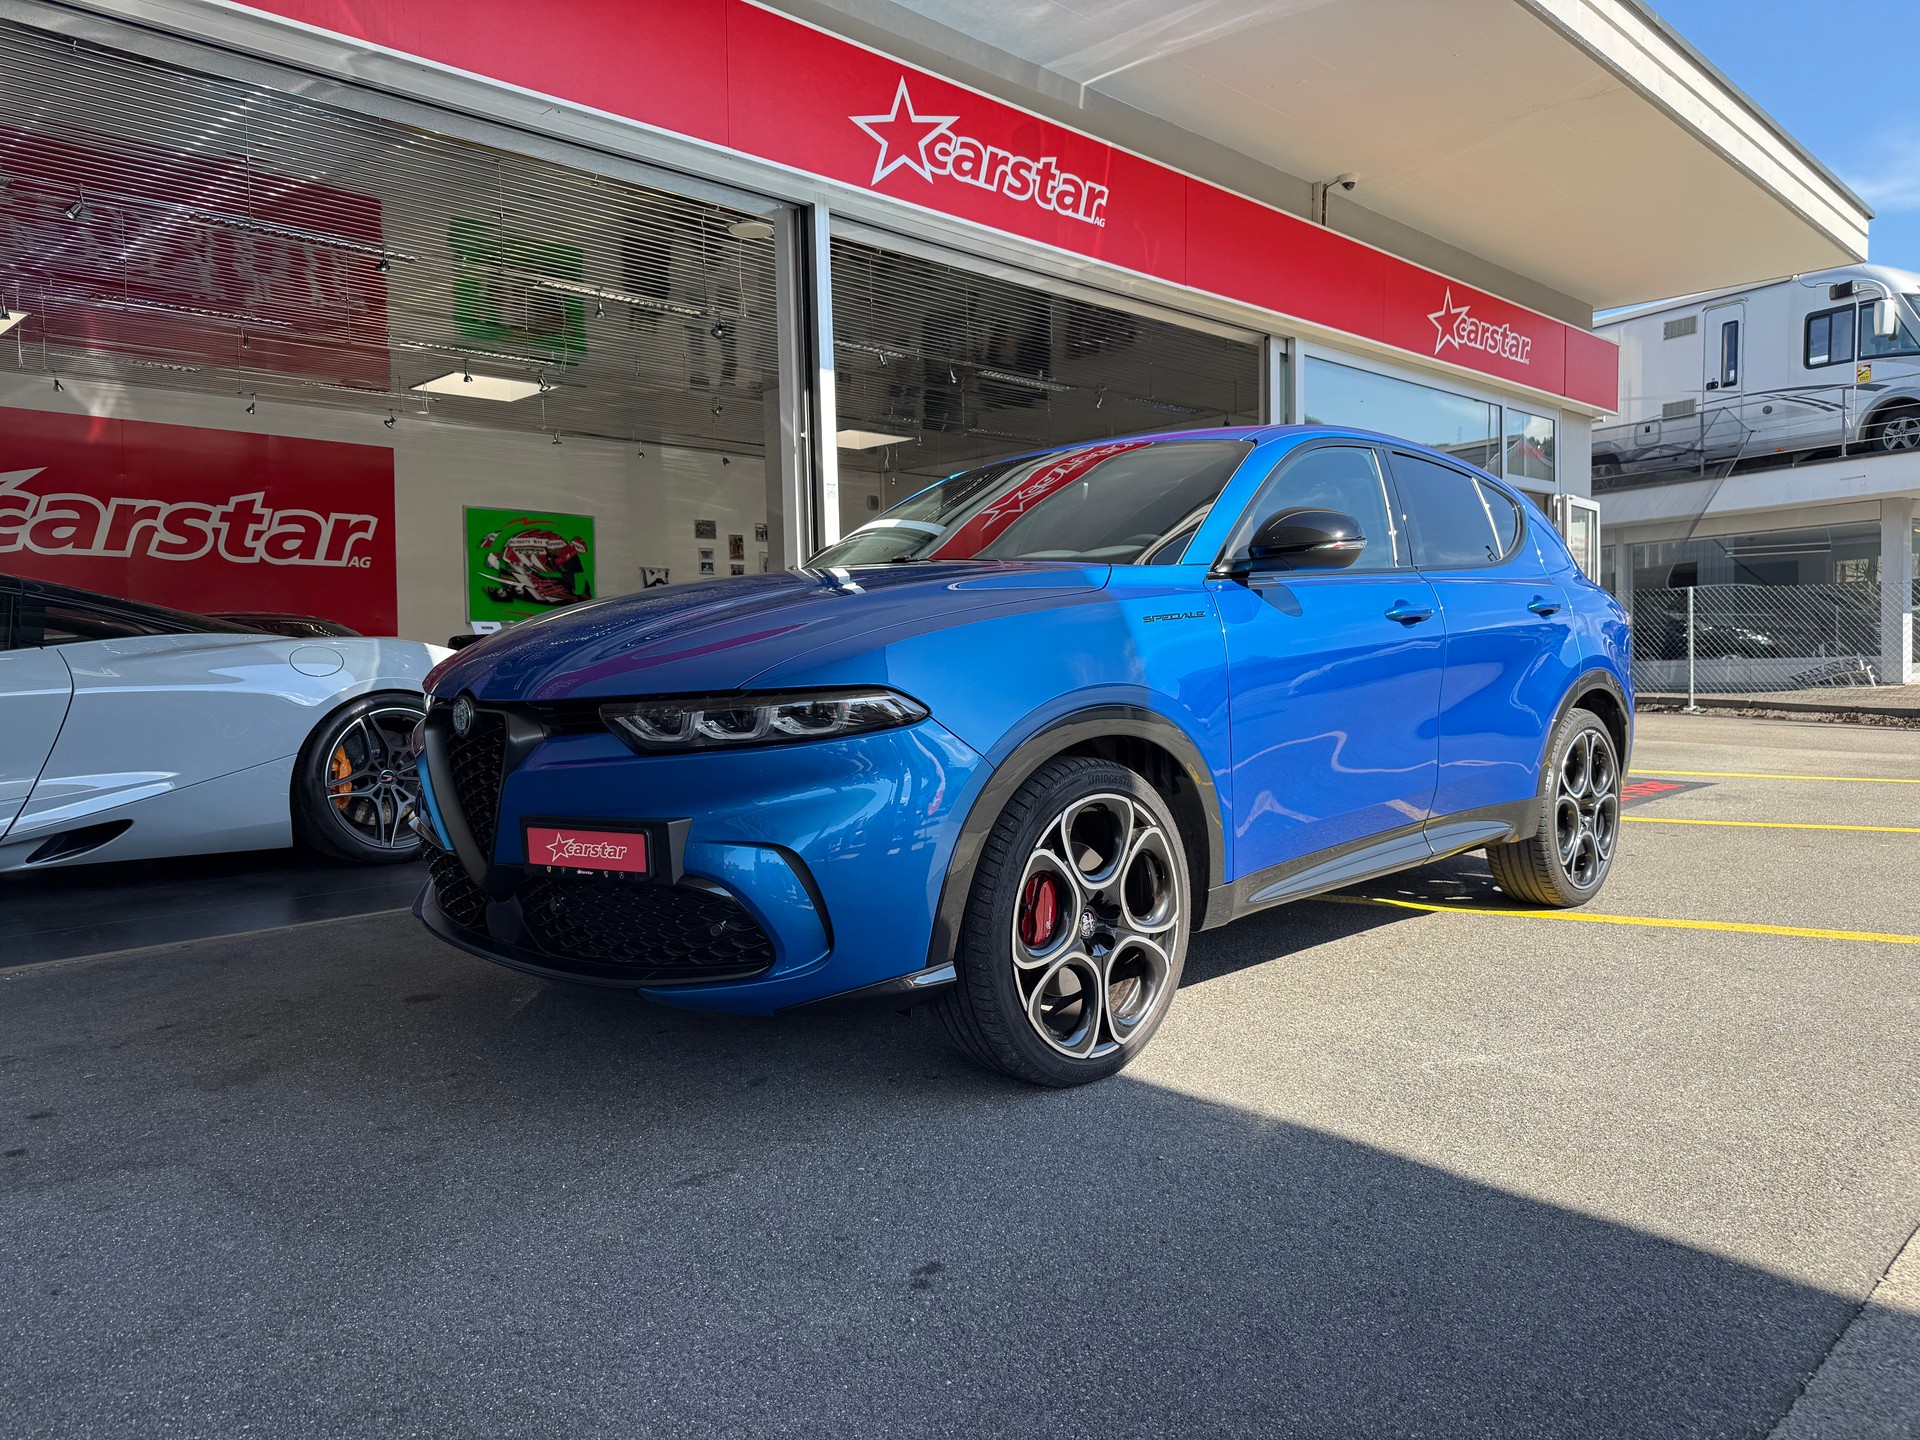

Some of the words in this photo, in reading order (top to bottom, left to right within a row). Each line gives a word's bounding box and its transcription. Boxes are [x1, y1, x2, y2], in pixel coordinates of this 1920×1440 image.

[924, 129, 1109, 223] carstar
[1094, 217, 1106, 228] AG
[1455, 314, 1532, 363] carstar
[347, 556, 372, 569] AG
[1087, 773, 1142, 793] BRIDGESTONE
[565, 841, 628, 860] carstar
